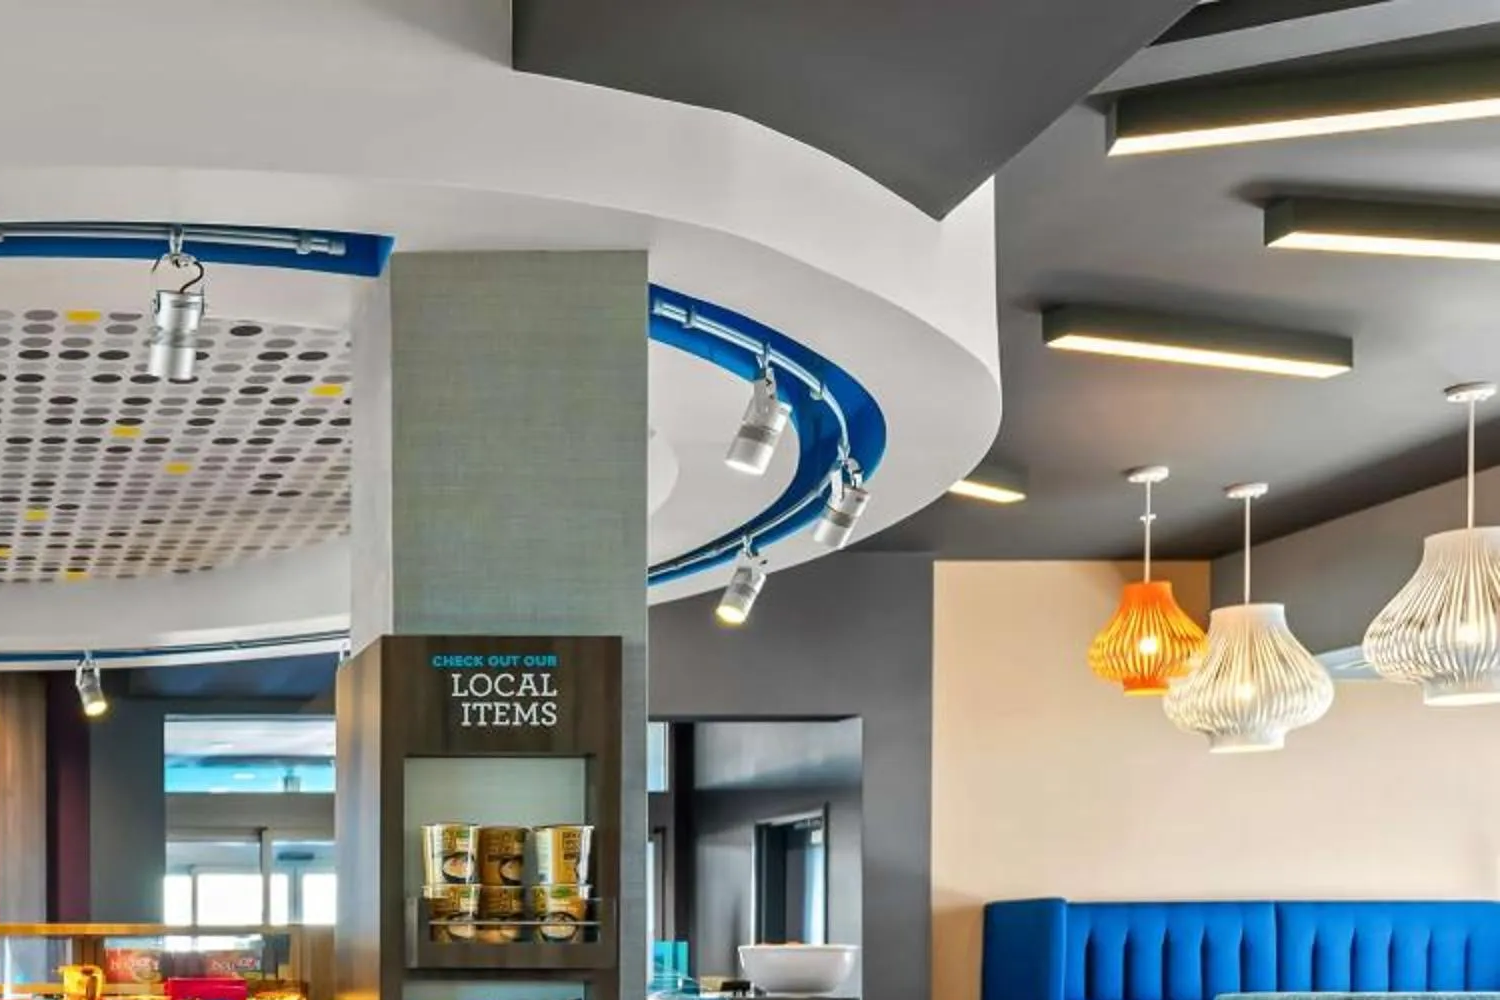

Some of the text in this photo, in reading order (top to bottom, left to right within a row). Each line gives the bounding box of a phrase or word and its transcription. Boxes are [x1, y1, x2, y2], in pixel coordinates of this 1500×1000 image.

[431, 655, 557, 667] CHECK OUT OUR
[451, 673, 557, 697] LOCAL
[461, 702, 557, 727] ITEMS
